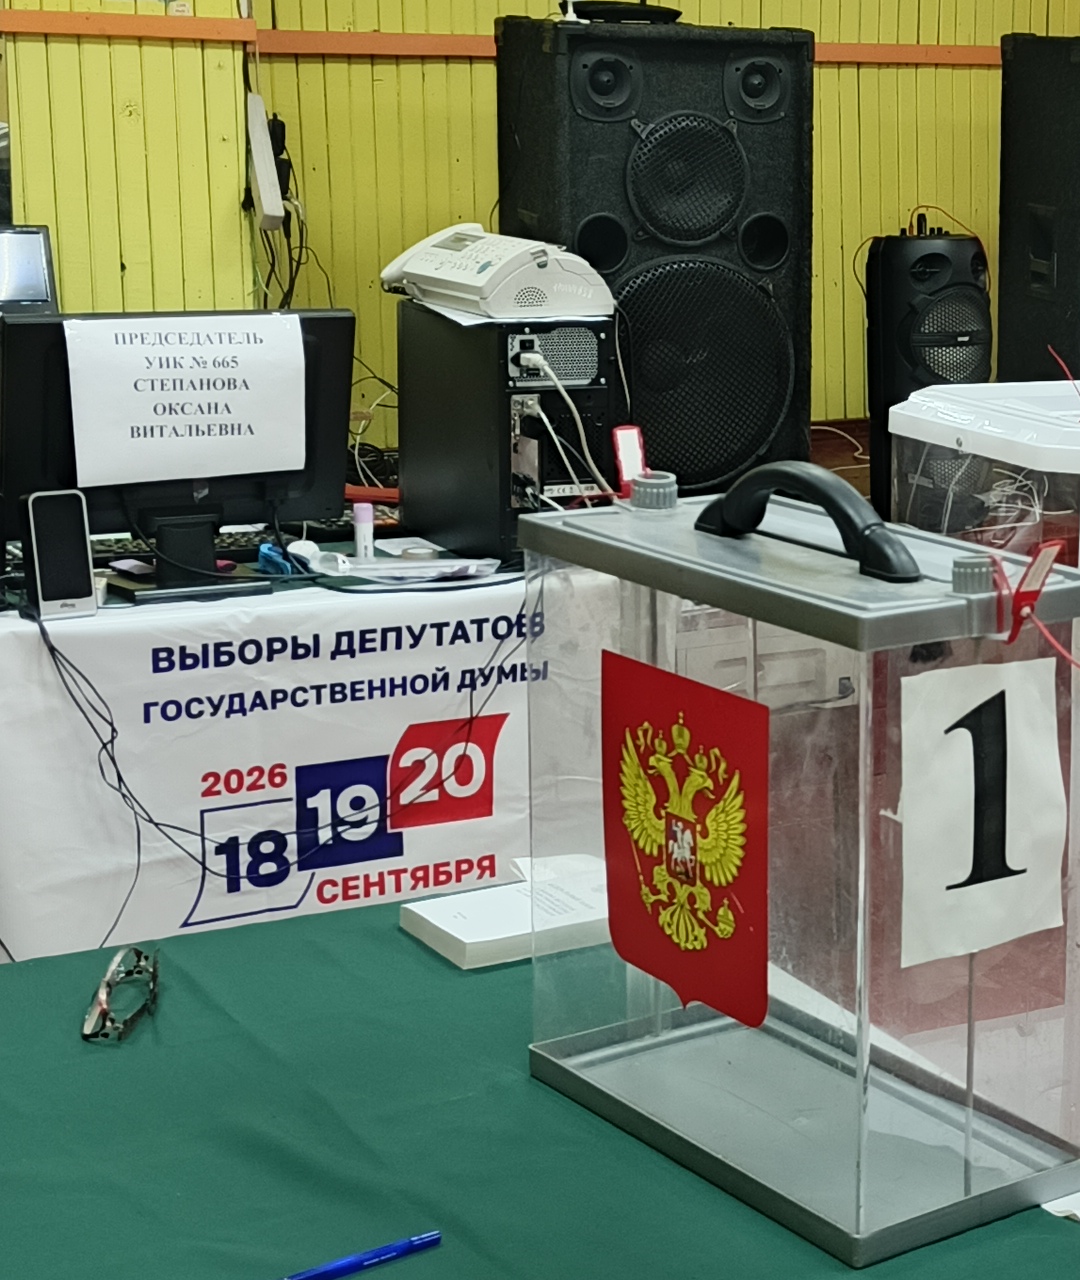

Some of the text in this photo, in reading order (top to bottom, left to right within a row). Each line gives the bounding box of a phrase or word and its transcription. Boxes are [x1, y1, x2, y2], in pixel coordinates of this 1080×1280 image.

[114, 331, 264, 347] ПРЕДСЕДАТЕЛЬ
[144, 355, 239, 369] УИК № 665
[133, 377, 250, 392] СТЕПАНОВА
[153, 402, 232, 416] ОКСАНА
[130, 423, 255, 438] ВИТАЛЬЕВНА
[152, 611, 545, 674] ВЫБОРЫ ДЕПУТАТОВ
[143, 660, 548, 723] ГОСУДАРСТВЕННОЙ ДУМЫ
[201, 763, 288, 798] 2026
[943, 689, 1027, 891] 1
[214, 742, 487, 894] 18 19 20
[316, 854, 497, 904] СЕНТЯБРЯ
